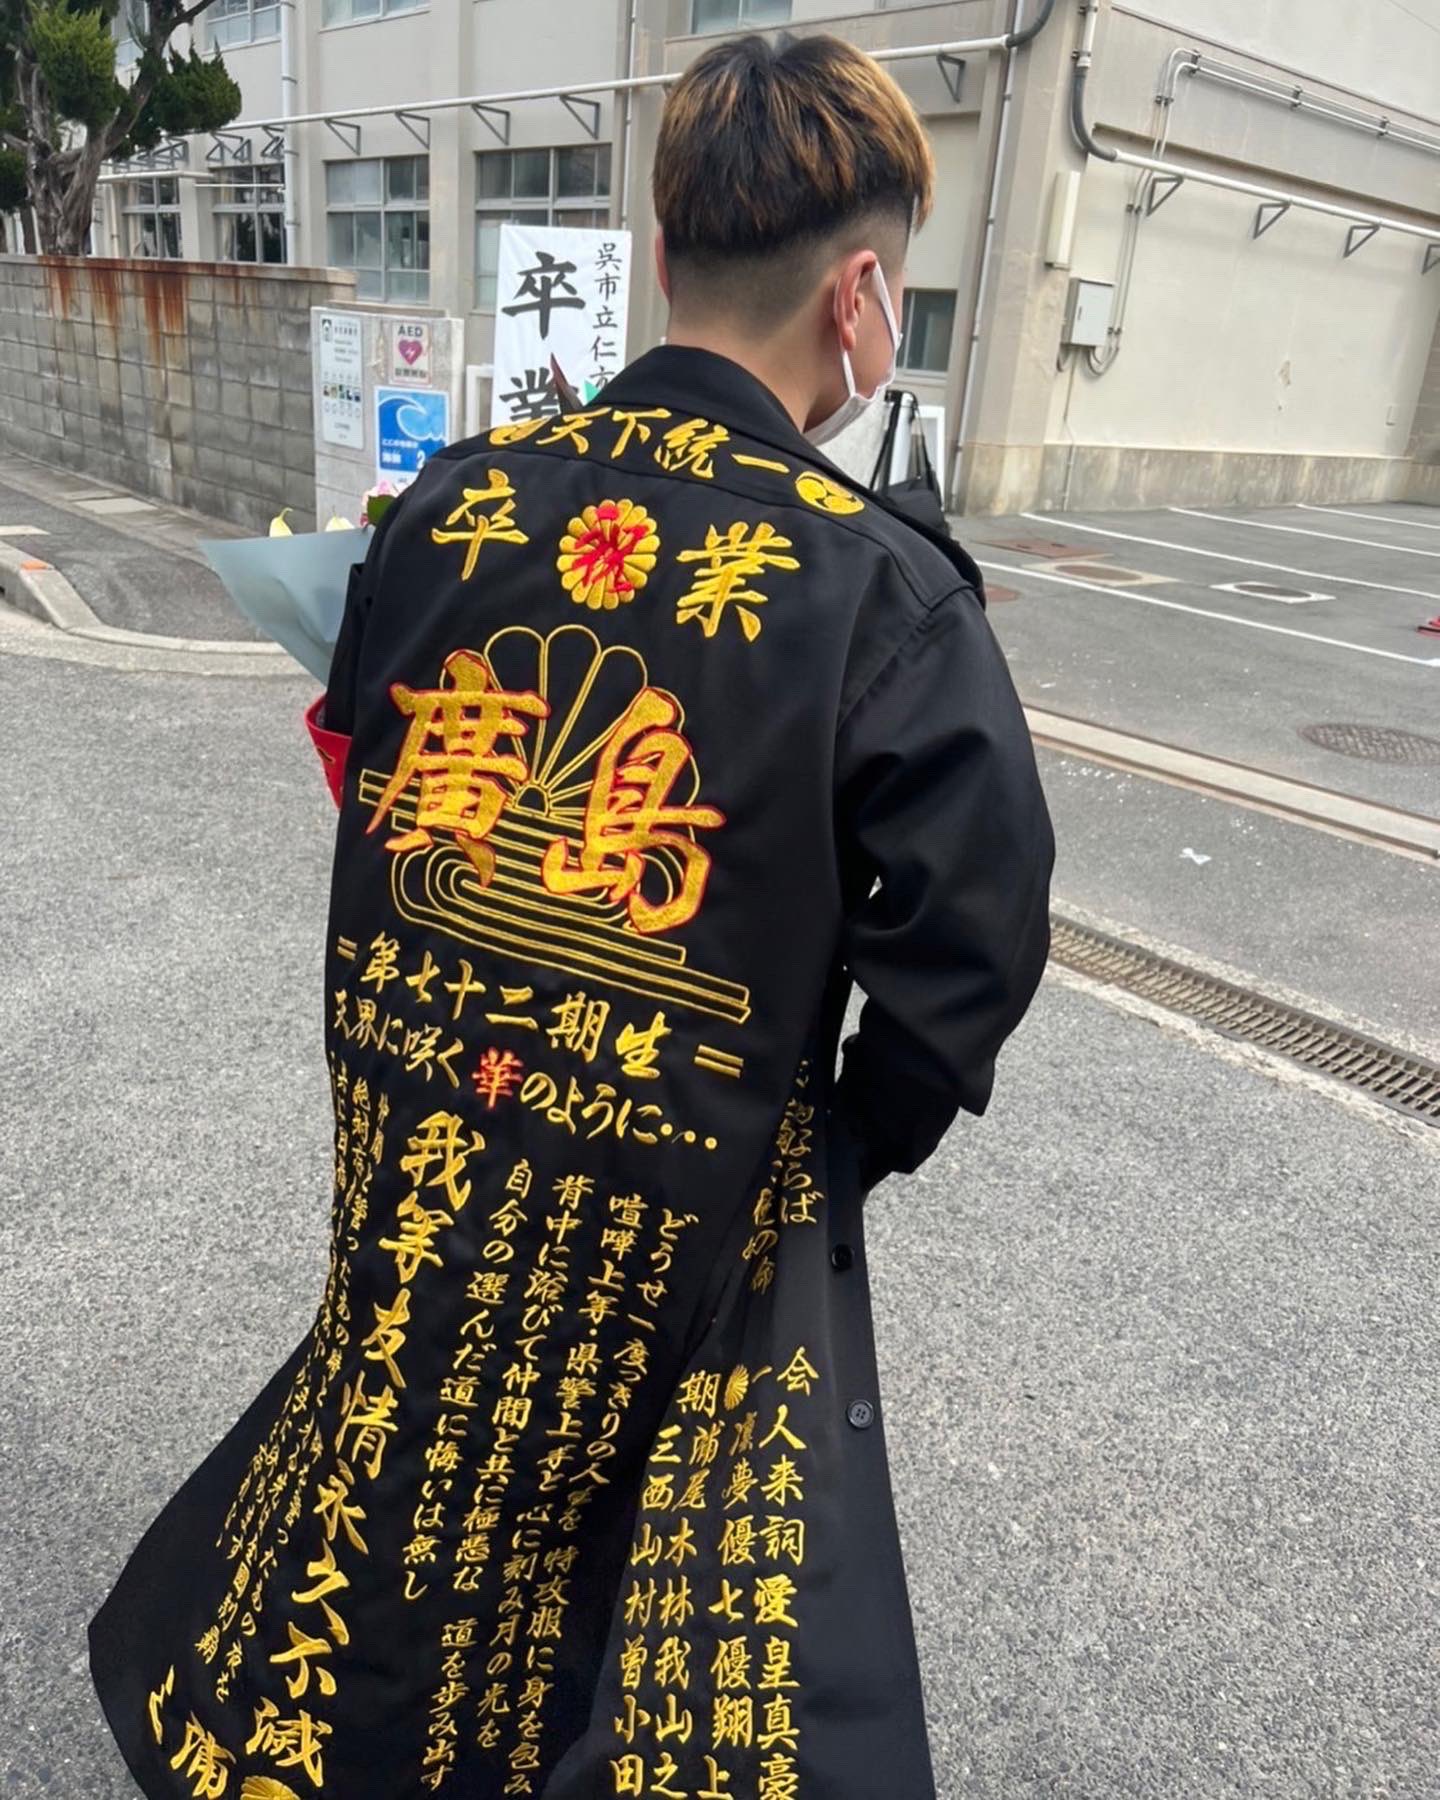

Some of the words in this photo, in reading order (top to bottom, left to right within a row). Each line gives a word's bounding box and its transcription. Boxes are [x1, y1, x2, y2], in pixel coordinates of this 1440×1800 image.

[397, 325, 424, 338] AED
[534, 406, 790, 479] 天下統一
[360, 930, 672, 1080] 第七十二期生
[642, 1468, 711, 1512] 西尾
[624, 1574, 695, 1629] 村林
[620, 1633, 692, 1690] 曽我
[614, 1693, 693, 1744] 小山
[711, 1693, 801, 1750] 翔真
